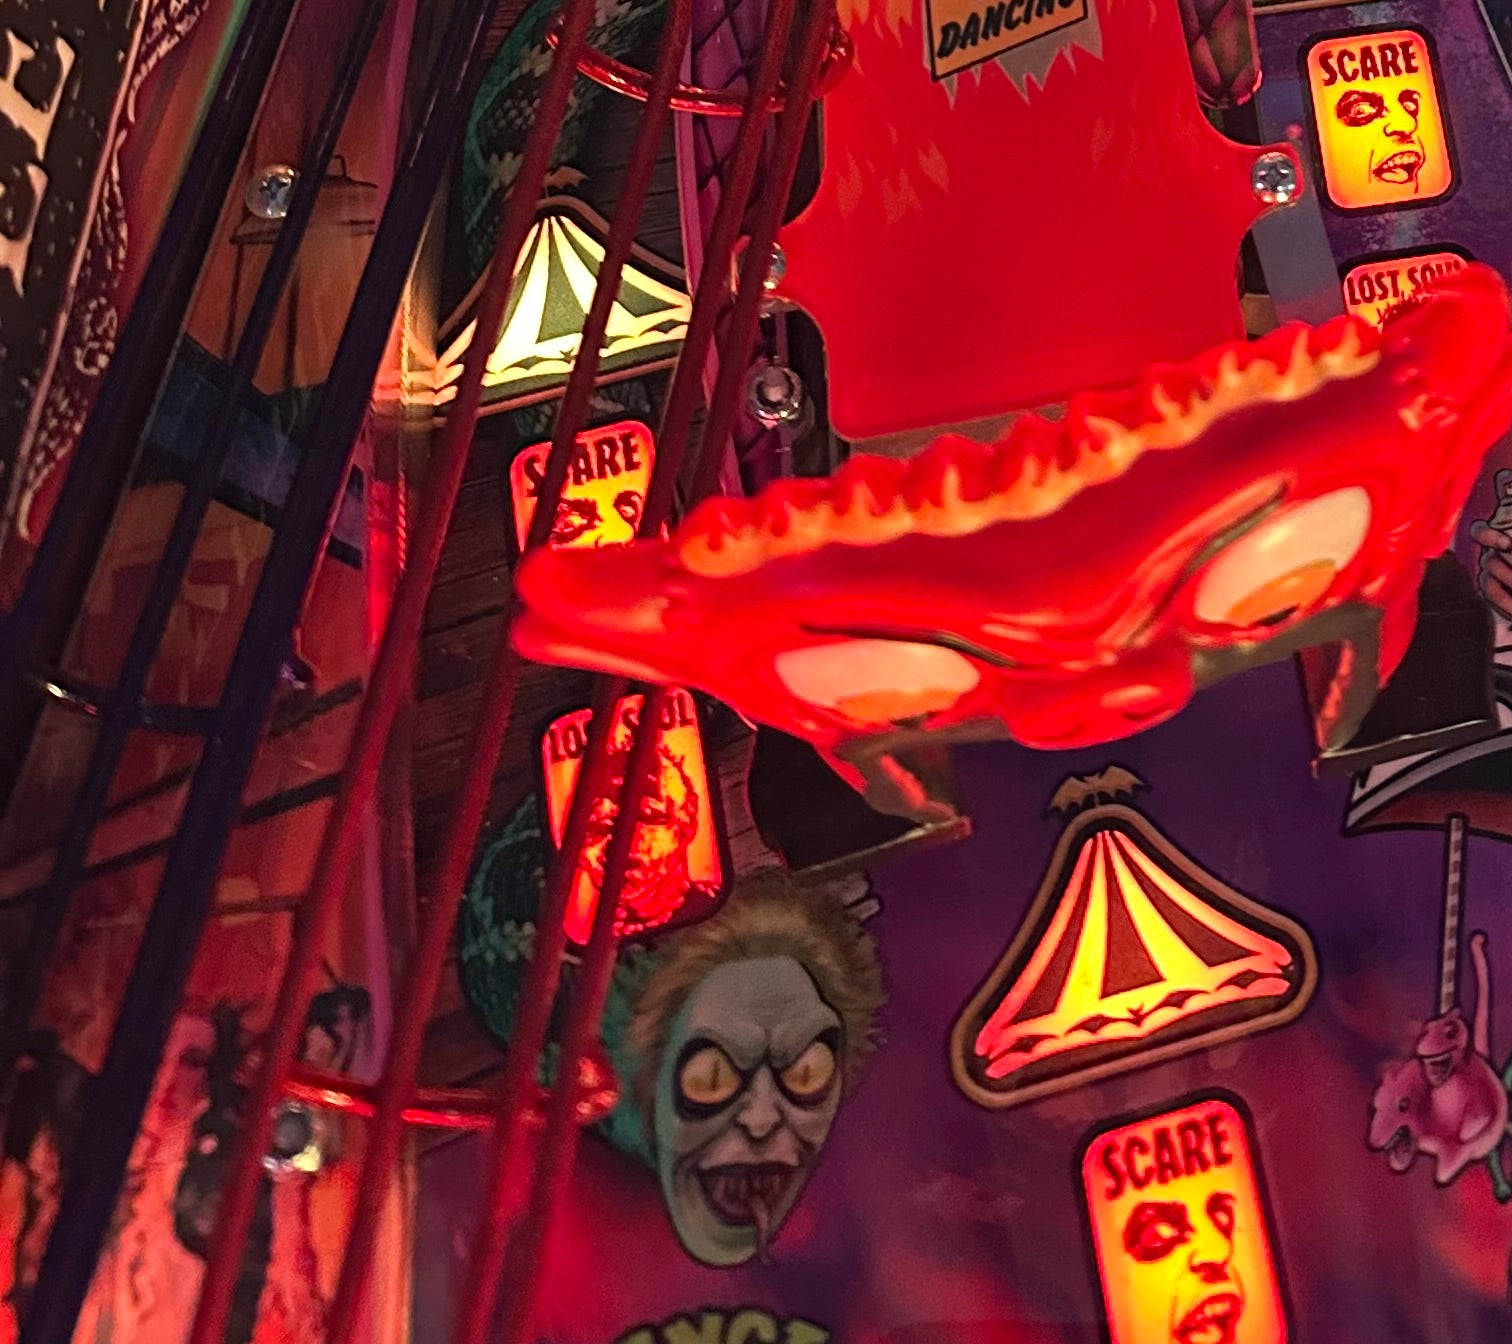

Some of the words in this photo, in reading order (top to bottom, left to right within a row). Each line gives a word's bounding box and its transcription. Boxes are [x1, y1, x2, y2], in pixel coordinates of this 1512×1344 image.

[1318, 39, 1421, 88] SCARE
[1346, 268, 1400, 306] LOST
[524, 430, 642, 498] SARE
[1101, 1112, 1233, 1202] SCARE
